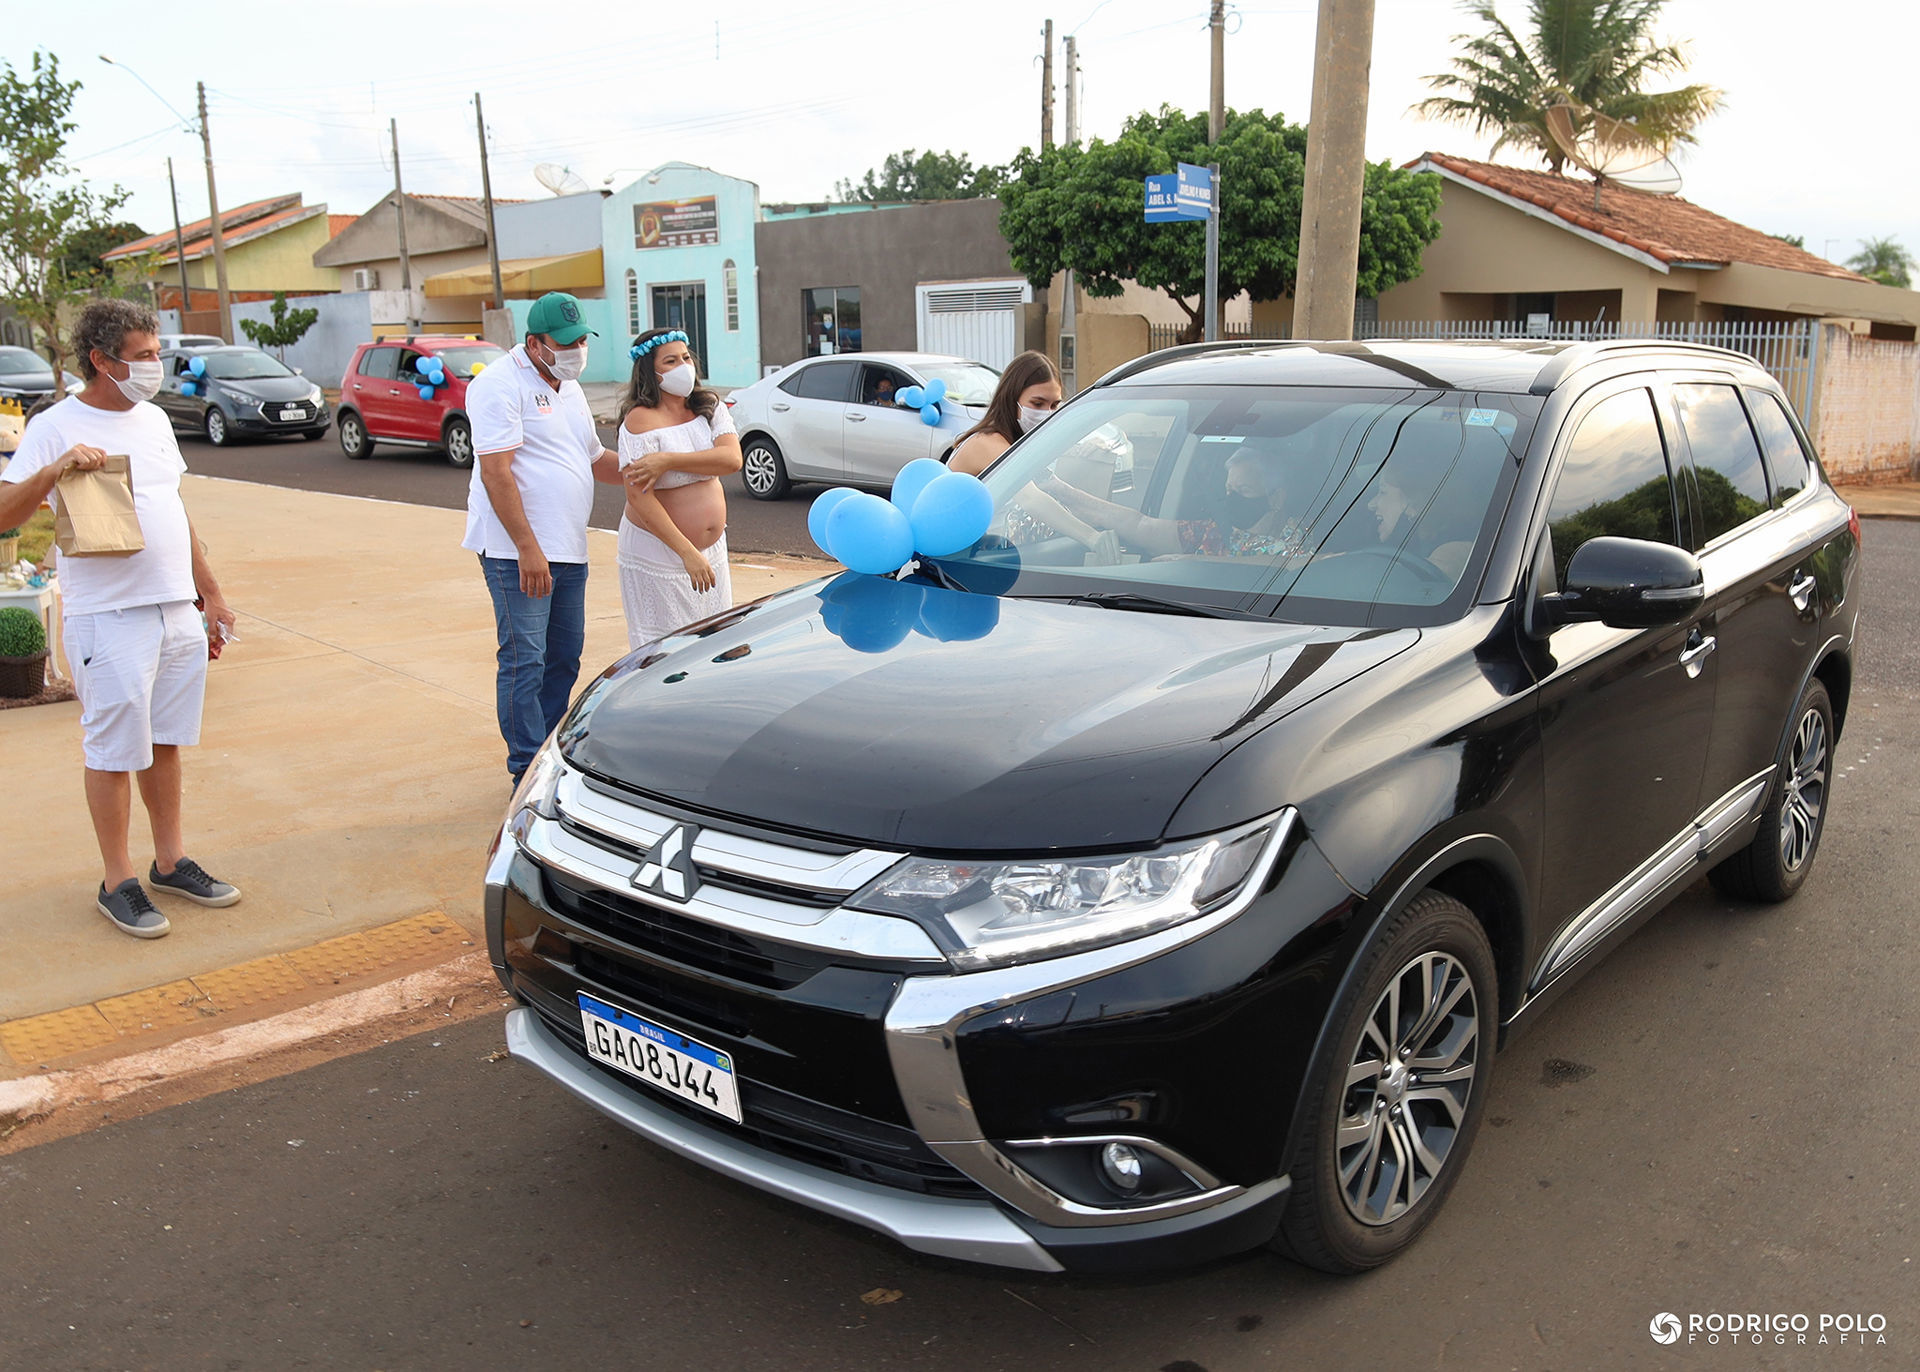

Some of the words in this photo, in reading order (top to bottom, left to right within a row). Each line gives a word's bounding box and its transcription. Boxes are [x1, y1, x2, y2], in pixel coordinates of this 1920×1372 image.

[1149, 181, 1161, 192] Rua
[1148, 194, 1165, 205] ABEL
[1166, 193, 1173, 204] S.
[640, 1024, 666, 1042] BRASIL
